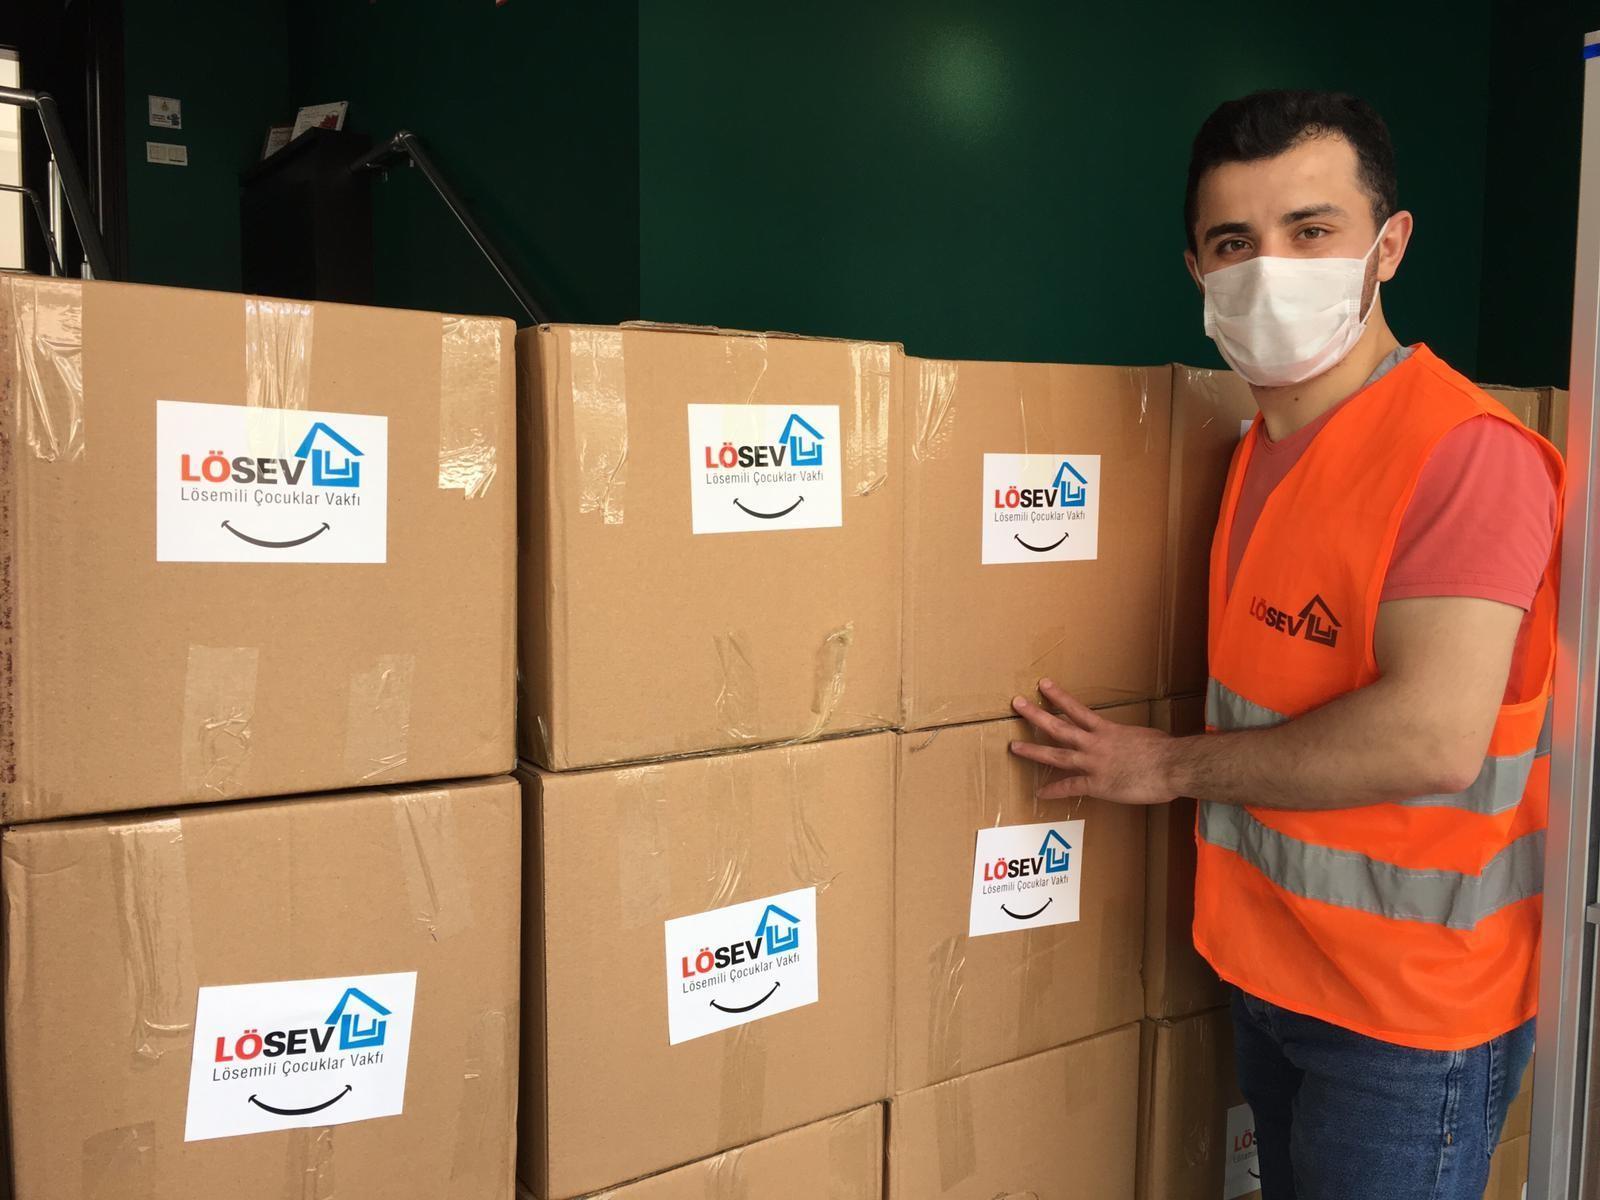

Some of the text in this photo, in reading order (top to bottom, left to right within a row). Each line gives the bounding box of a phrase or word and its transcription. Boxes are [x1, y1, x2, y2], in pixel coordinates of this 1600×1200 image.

[181, 450, 306, 485] LÖSEV
[705, 442, 787, 469] LÖSEV
[706, 470, 824, 485] Lösemili Çocuklar Vakfı
[181, 487, 361, 507] Lösemili Çocuklar Vakfı
[995, 486, 1058, 508] LÖSEV
[994, 510, 1086, 524] Lösemili Çocuklar Vakfı
[1249, 595, 1305, 637] LÖSEV
[983, 857, 1044, 882] LÖSEV
[982, 875, 1069, 895] Lösemili Çocuklar Vakfı
[682, 937, 763, 978] LÖSEV
[683, 954, 800, 994] Lösemili Çocuklar Vakfı
[214, 1025, 336, 1063] LÖSEV
[212, 1051, 384, 1082] Lösemili Çocuklar Vakfı
